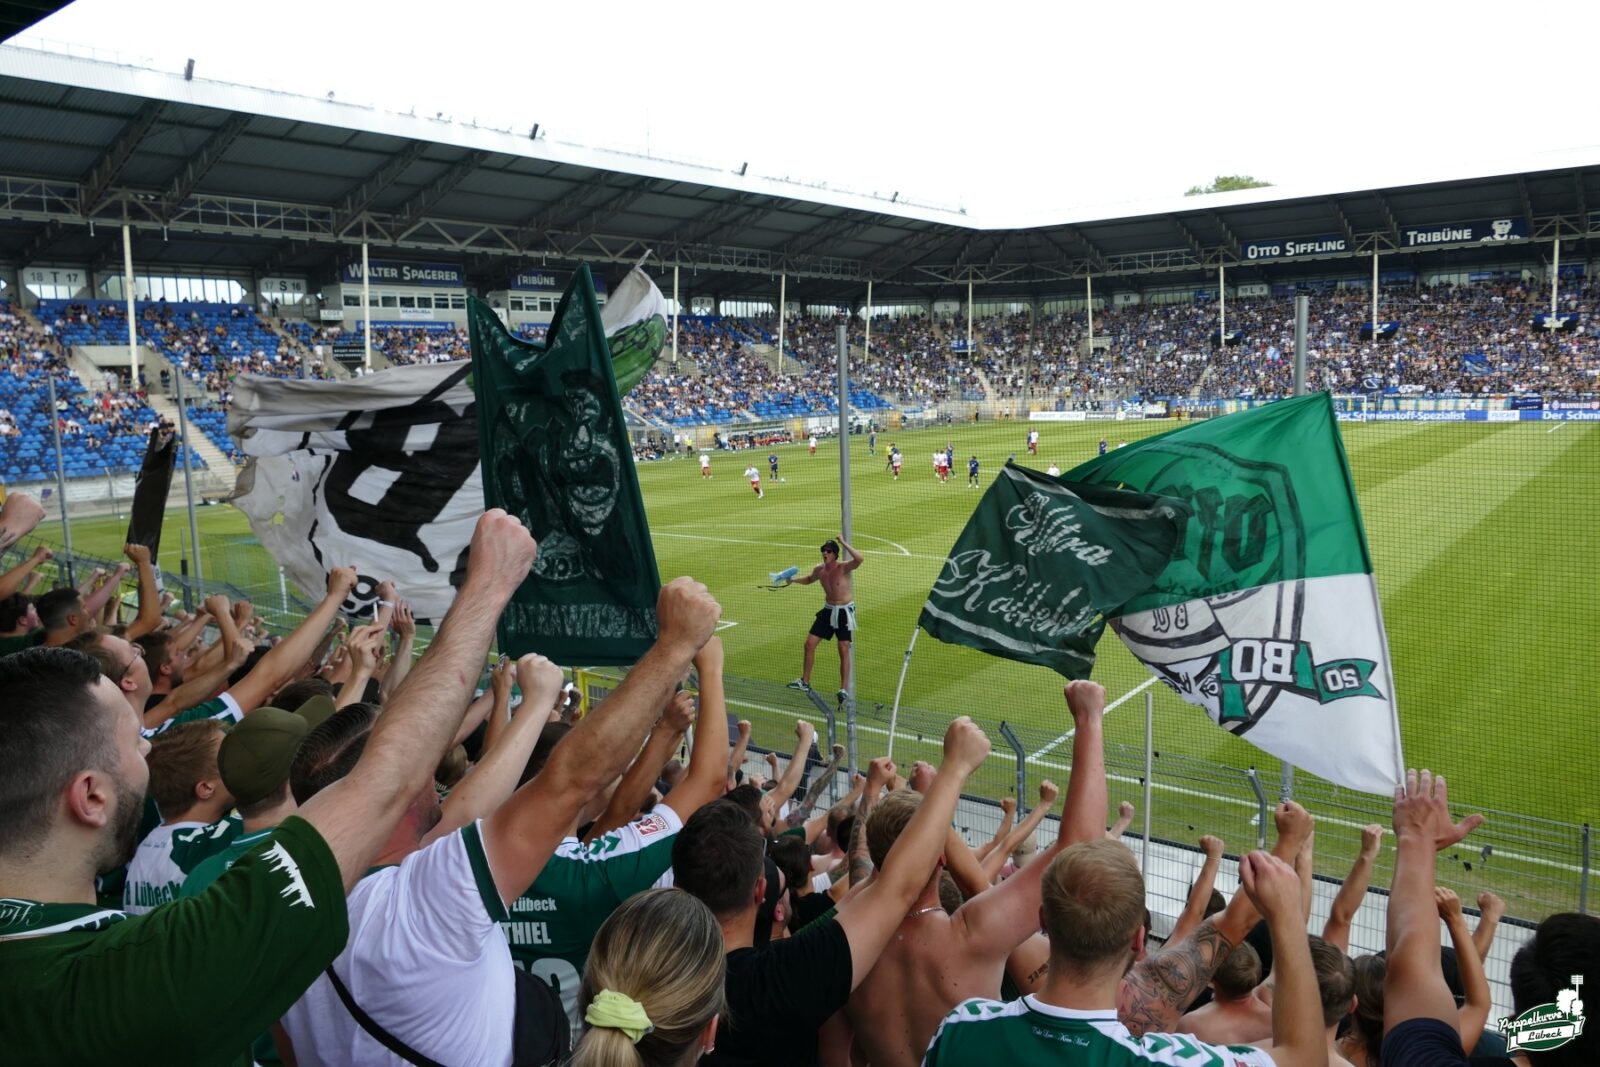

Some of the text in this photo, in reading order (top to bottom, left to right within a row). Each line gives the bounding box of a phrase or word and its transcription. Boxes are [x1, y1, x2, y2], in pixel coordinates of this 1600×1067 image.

[1407, 228, 1472, 246] TRIBÜNE
[1247, 239, 1346, 260] OTTO SIFFLING
[50, 271, 59, 283] T
[66, 273, 79, 283] 17
[402, 265, 459, 281] SPAGERER
[279, 280, 288, 292] S
[517, 274, 556, 286] TRIBÜNE
[1353, 410, 1466, 421] Schmierstoff-Spezialist
[1542, 411, 1564, 420] Der
[512, 897, 558, 912] Lübeck
